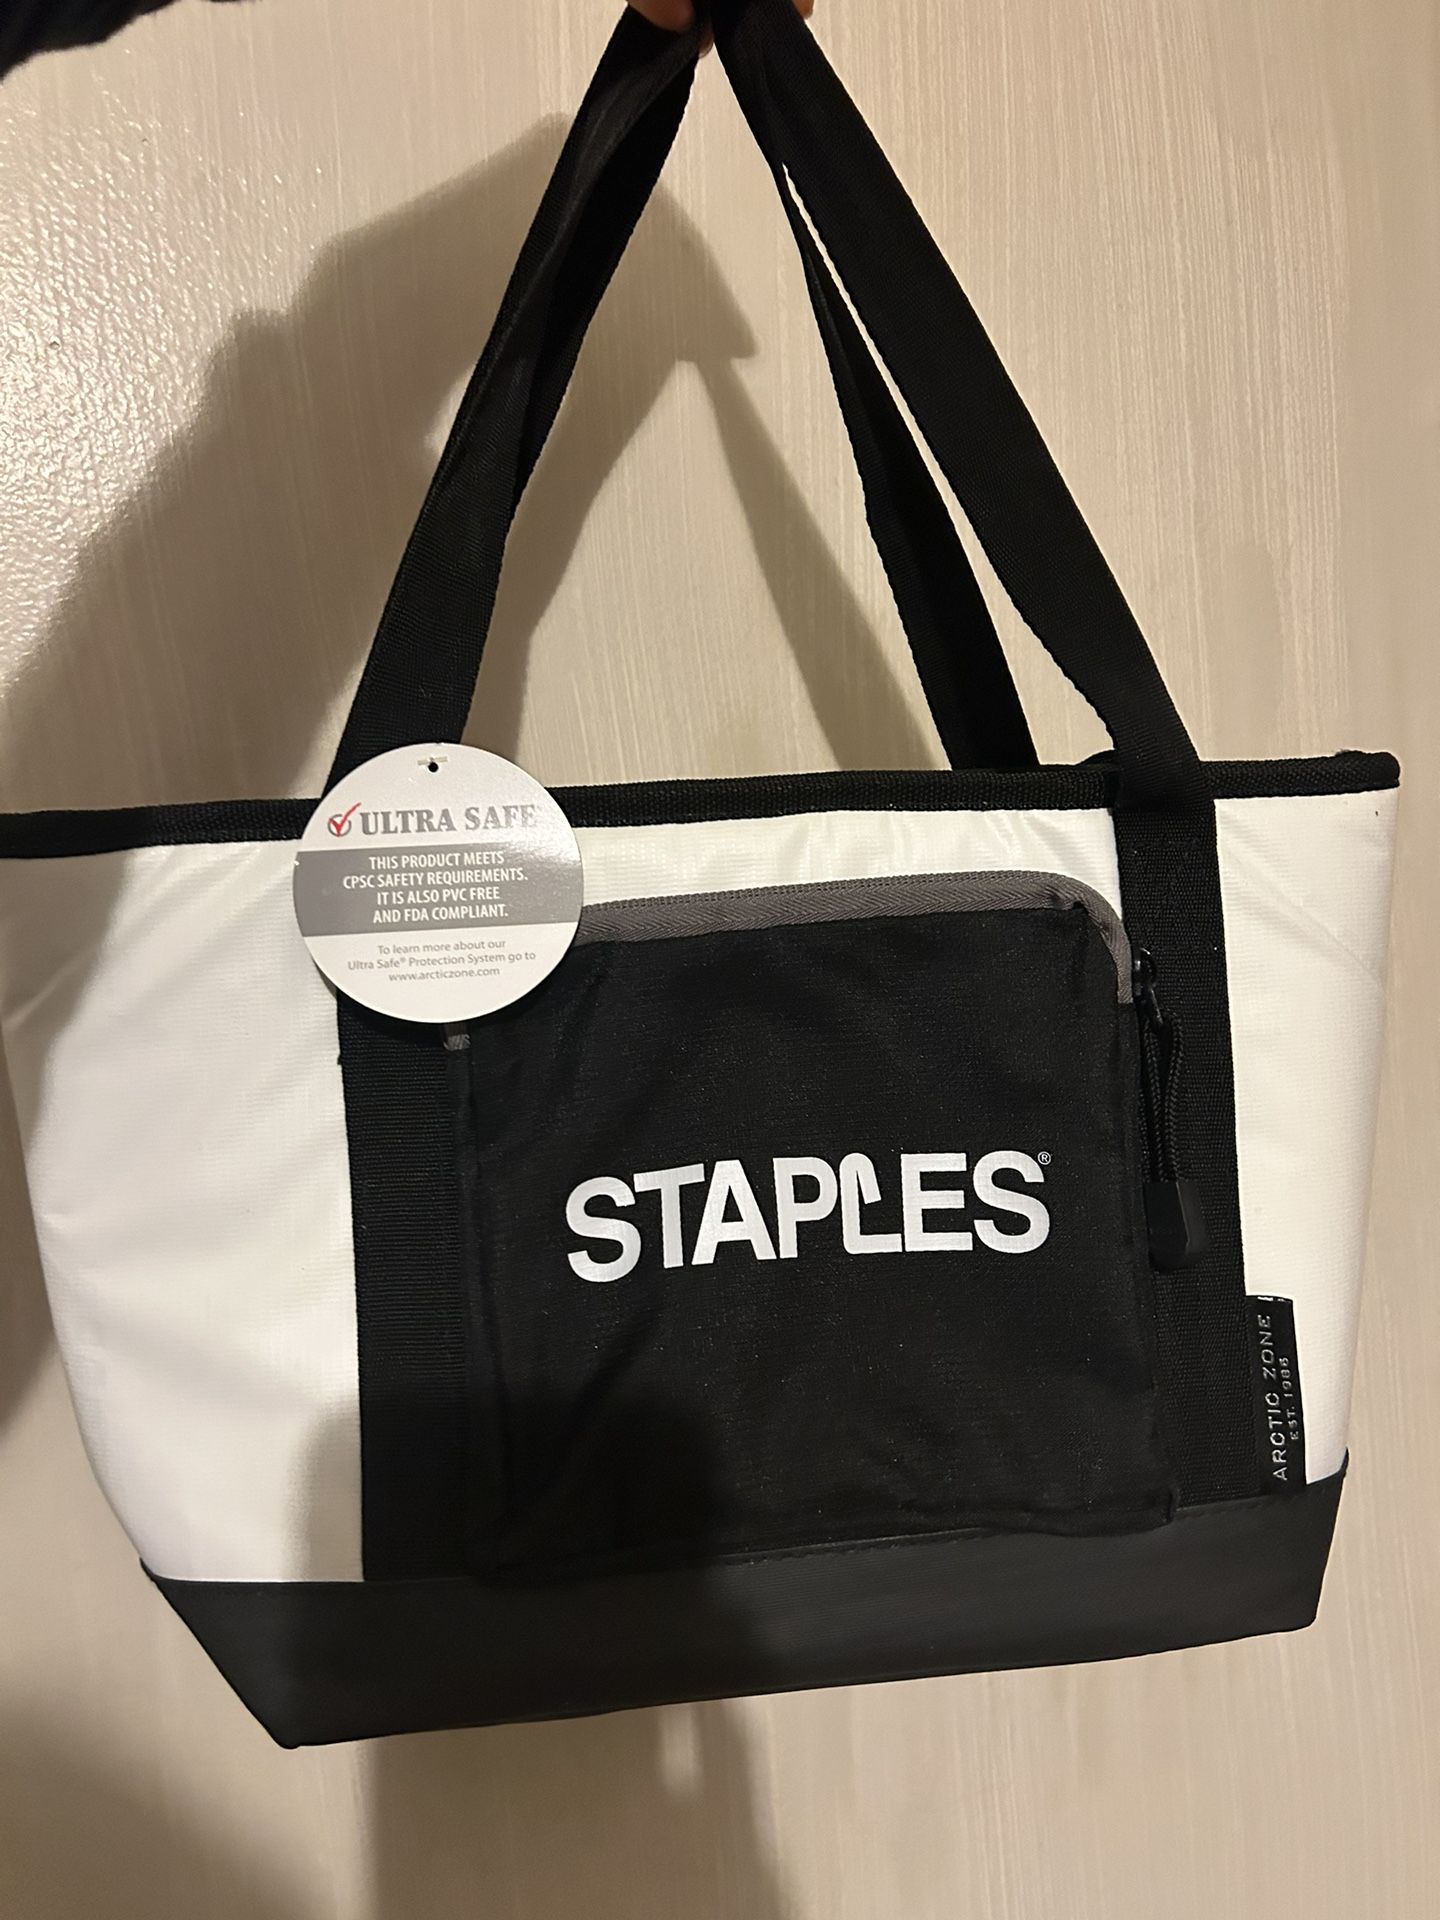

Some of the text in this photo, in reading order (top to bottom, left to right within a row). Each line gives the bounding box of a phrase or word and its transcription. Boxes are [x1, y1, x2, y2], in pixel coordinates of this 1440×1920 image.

[360, 804, 536, 836] ULTRA SAFE
[369, 851, 504, 870] THIS PRODUCT MEETS
[343, 868, 528, 889] CPSC SAFETY REQUIREMENTS.
[376, 886, 500, 906] IT IS ALSO PVC FREE
[373, 904, 508, 924] AND FDA COMPLIANT.
[378, 940, 506, 955] To learn more about our
[348, 960, 374, 970] Ultra
[408, 955, 464, 967] Protection
[467, 953, 506, 966] System
[508, 953, 522, 965] go
[524, 951, 536, 960] to
[388, 966, 500, 982] www.arcticzone.com
[1257, 1314, 1287, 1480] ARCTIC ZONE
[1286, 1407, 1299, 1440] EST.
